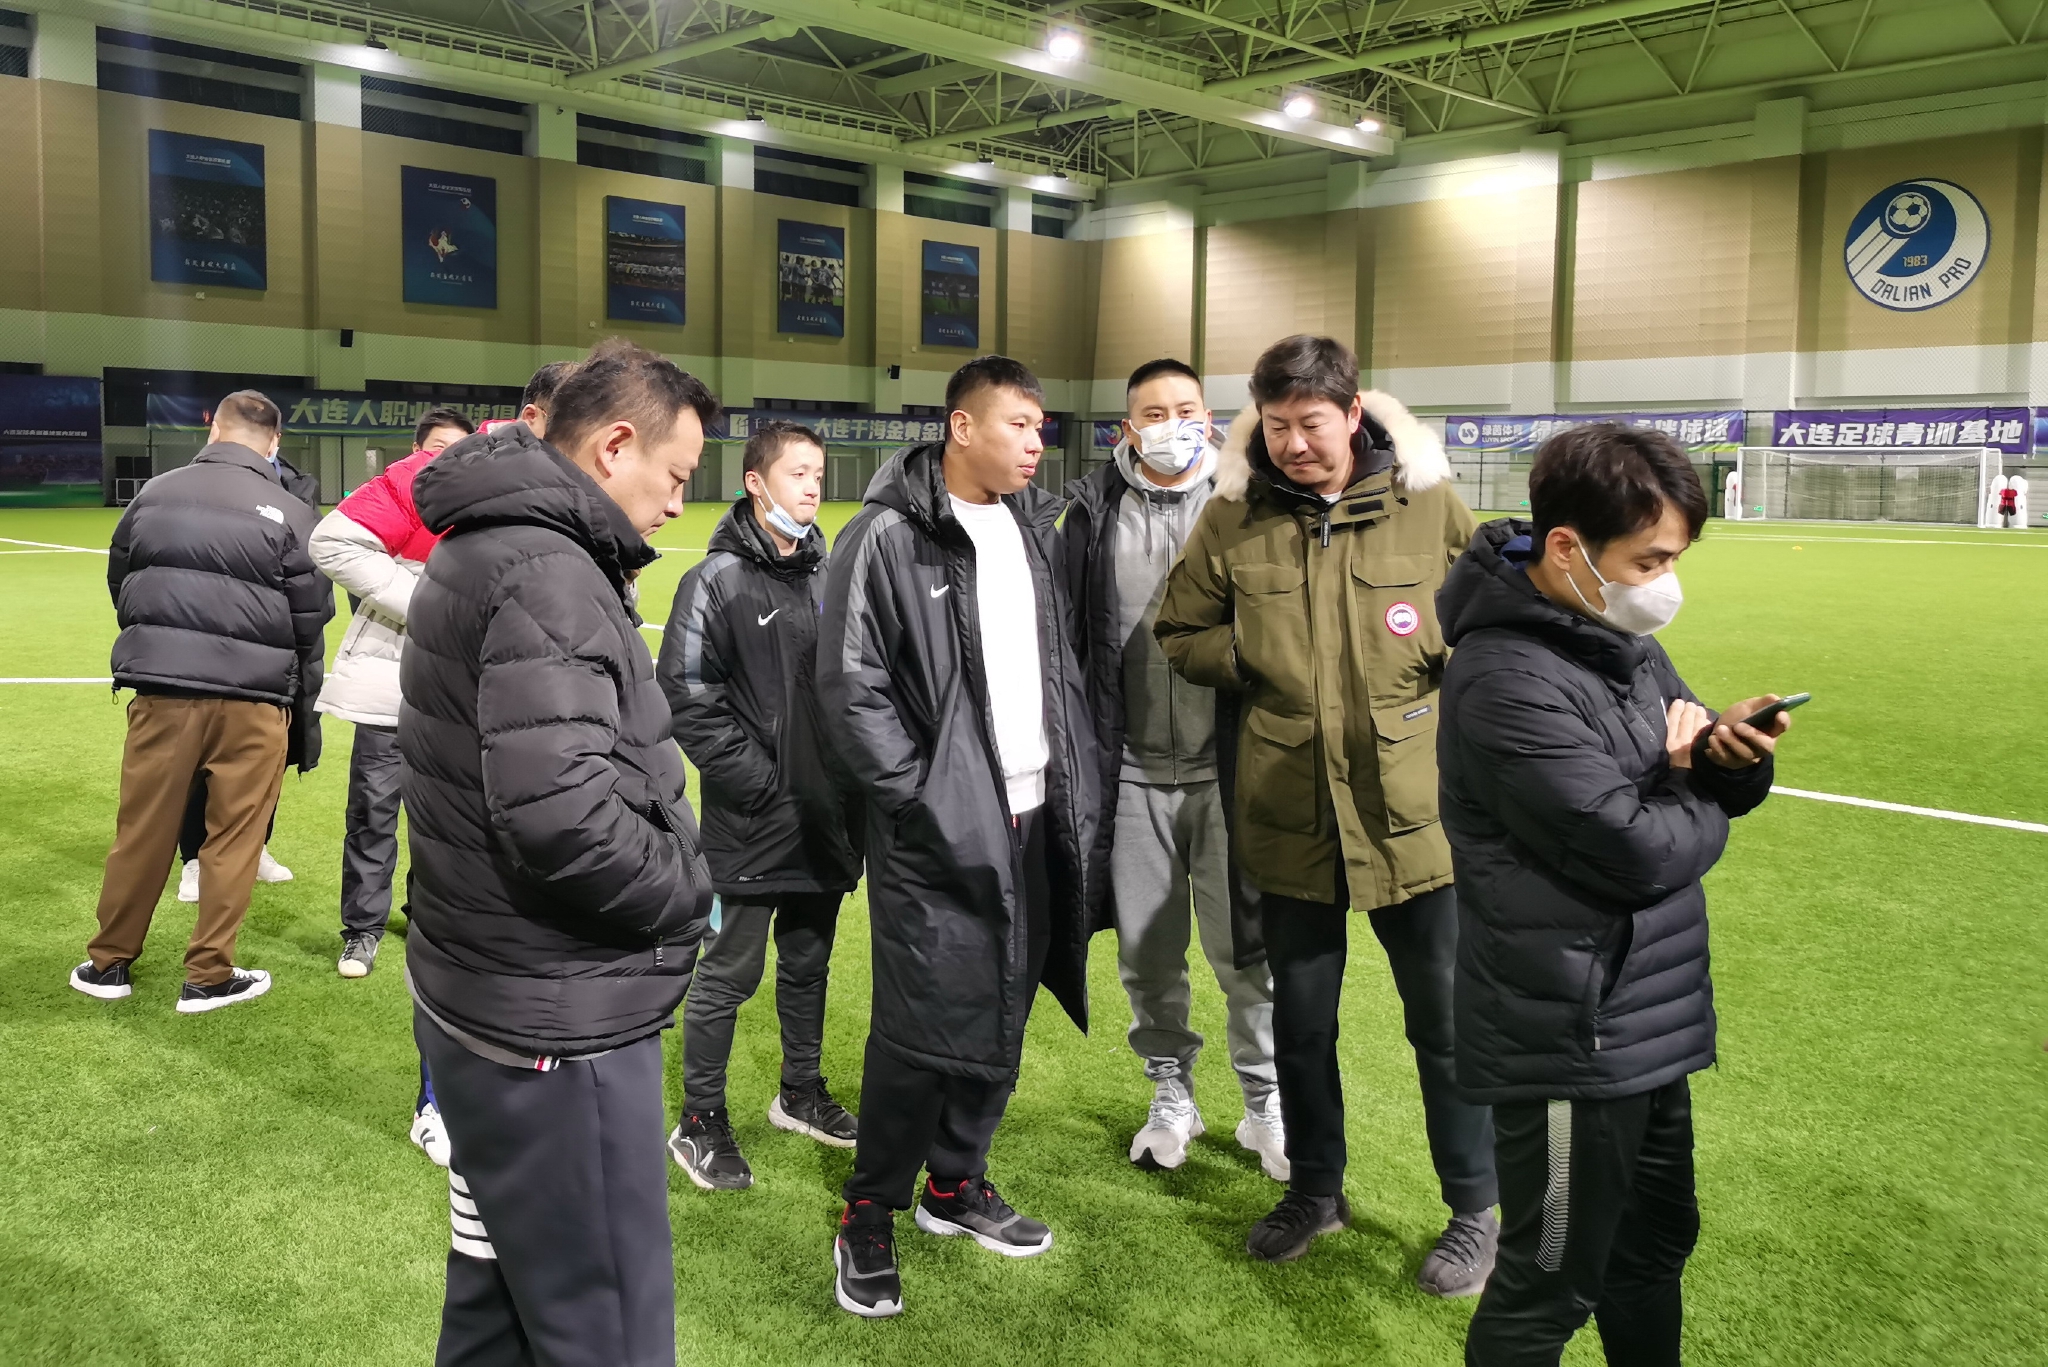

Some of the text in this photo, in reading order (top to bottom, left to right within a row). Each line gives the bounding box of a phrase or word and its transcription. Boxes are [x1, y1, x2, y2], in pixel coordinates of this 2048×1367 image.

[1903, 255, 1928, 268] 1983
[1870, 257, 1972, 302] DALIAN PRO
[1778, 419, 2024, 446] 大连足球青训基地
